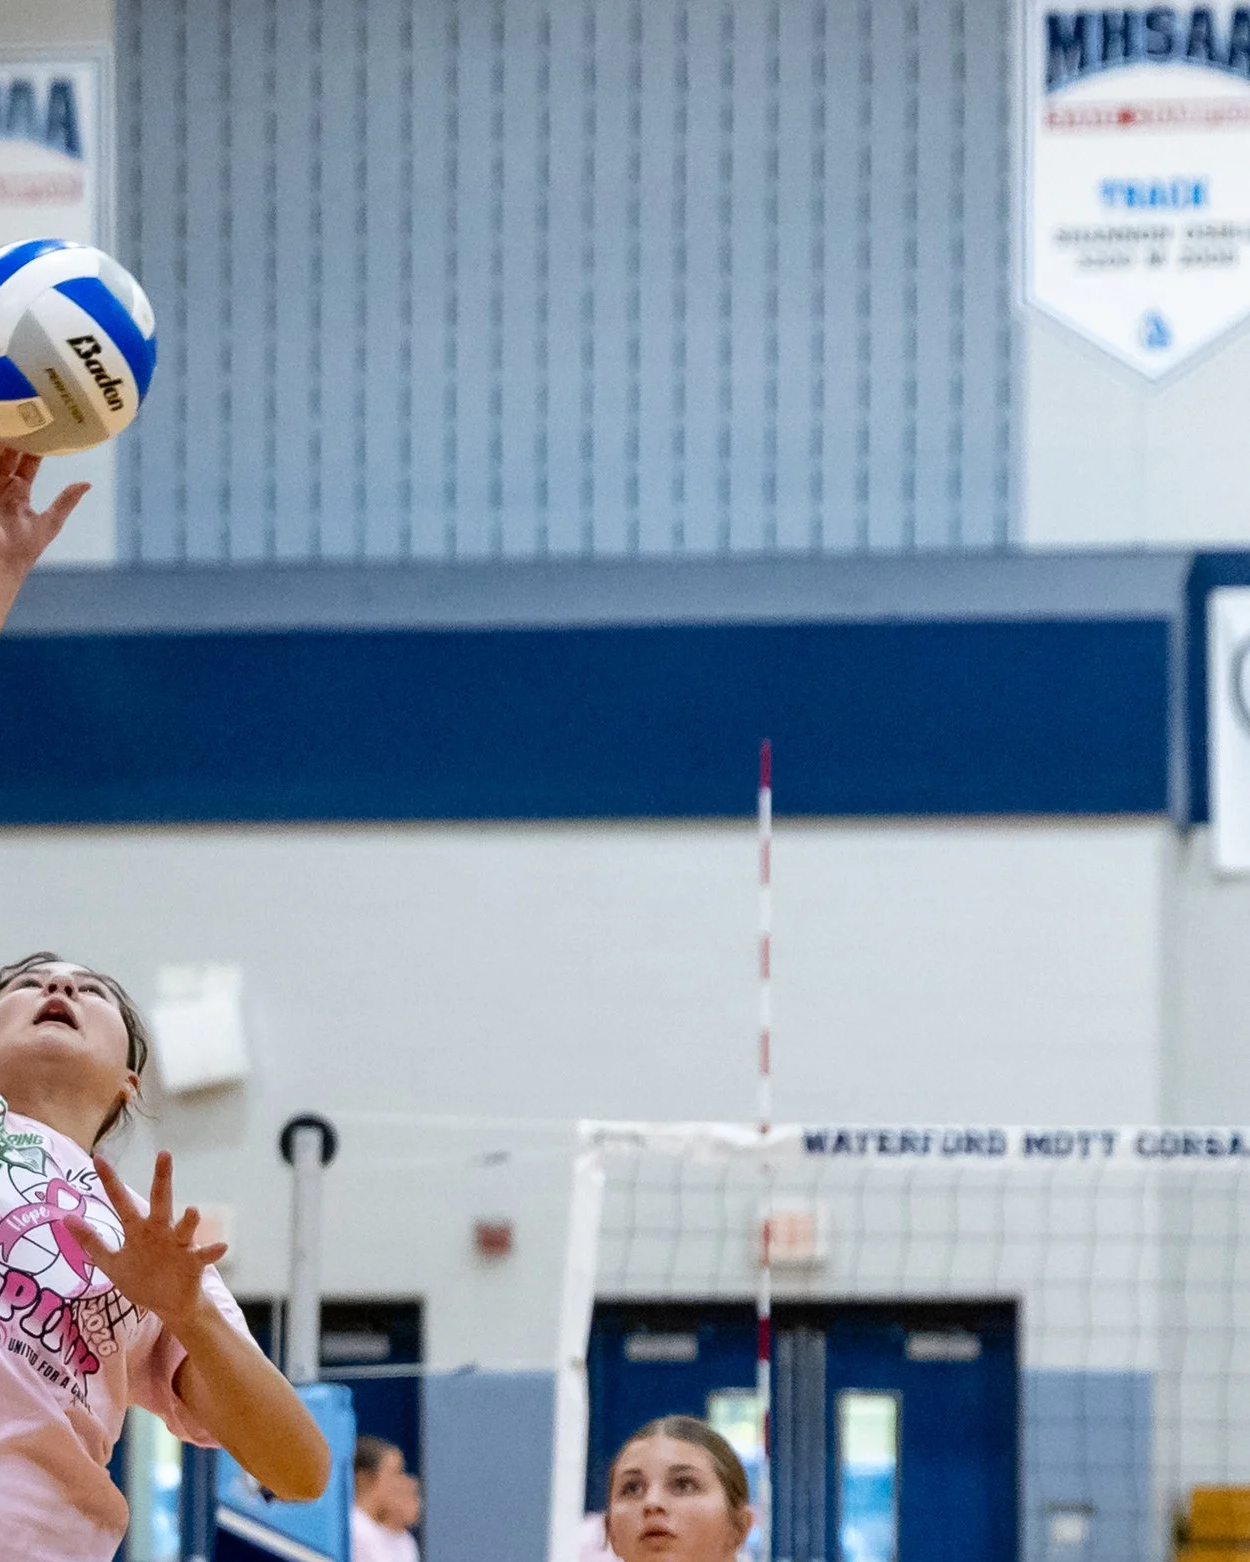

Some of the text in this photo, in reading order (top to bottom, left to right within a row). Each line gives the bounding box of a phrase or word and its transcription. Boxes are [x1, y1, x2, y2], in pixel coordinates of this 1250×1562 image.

[802, 1126, 1007, 1157] WATERFORD
[1022, 1127, 1117, 1157] MOTT
[6, 1205, 52, 1232] Hope
[37, 1360, 60, 1383] FOR
[60, 1376, 70, 1389] A
